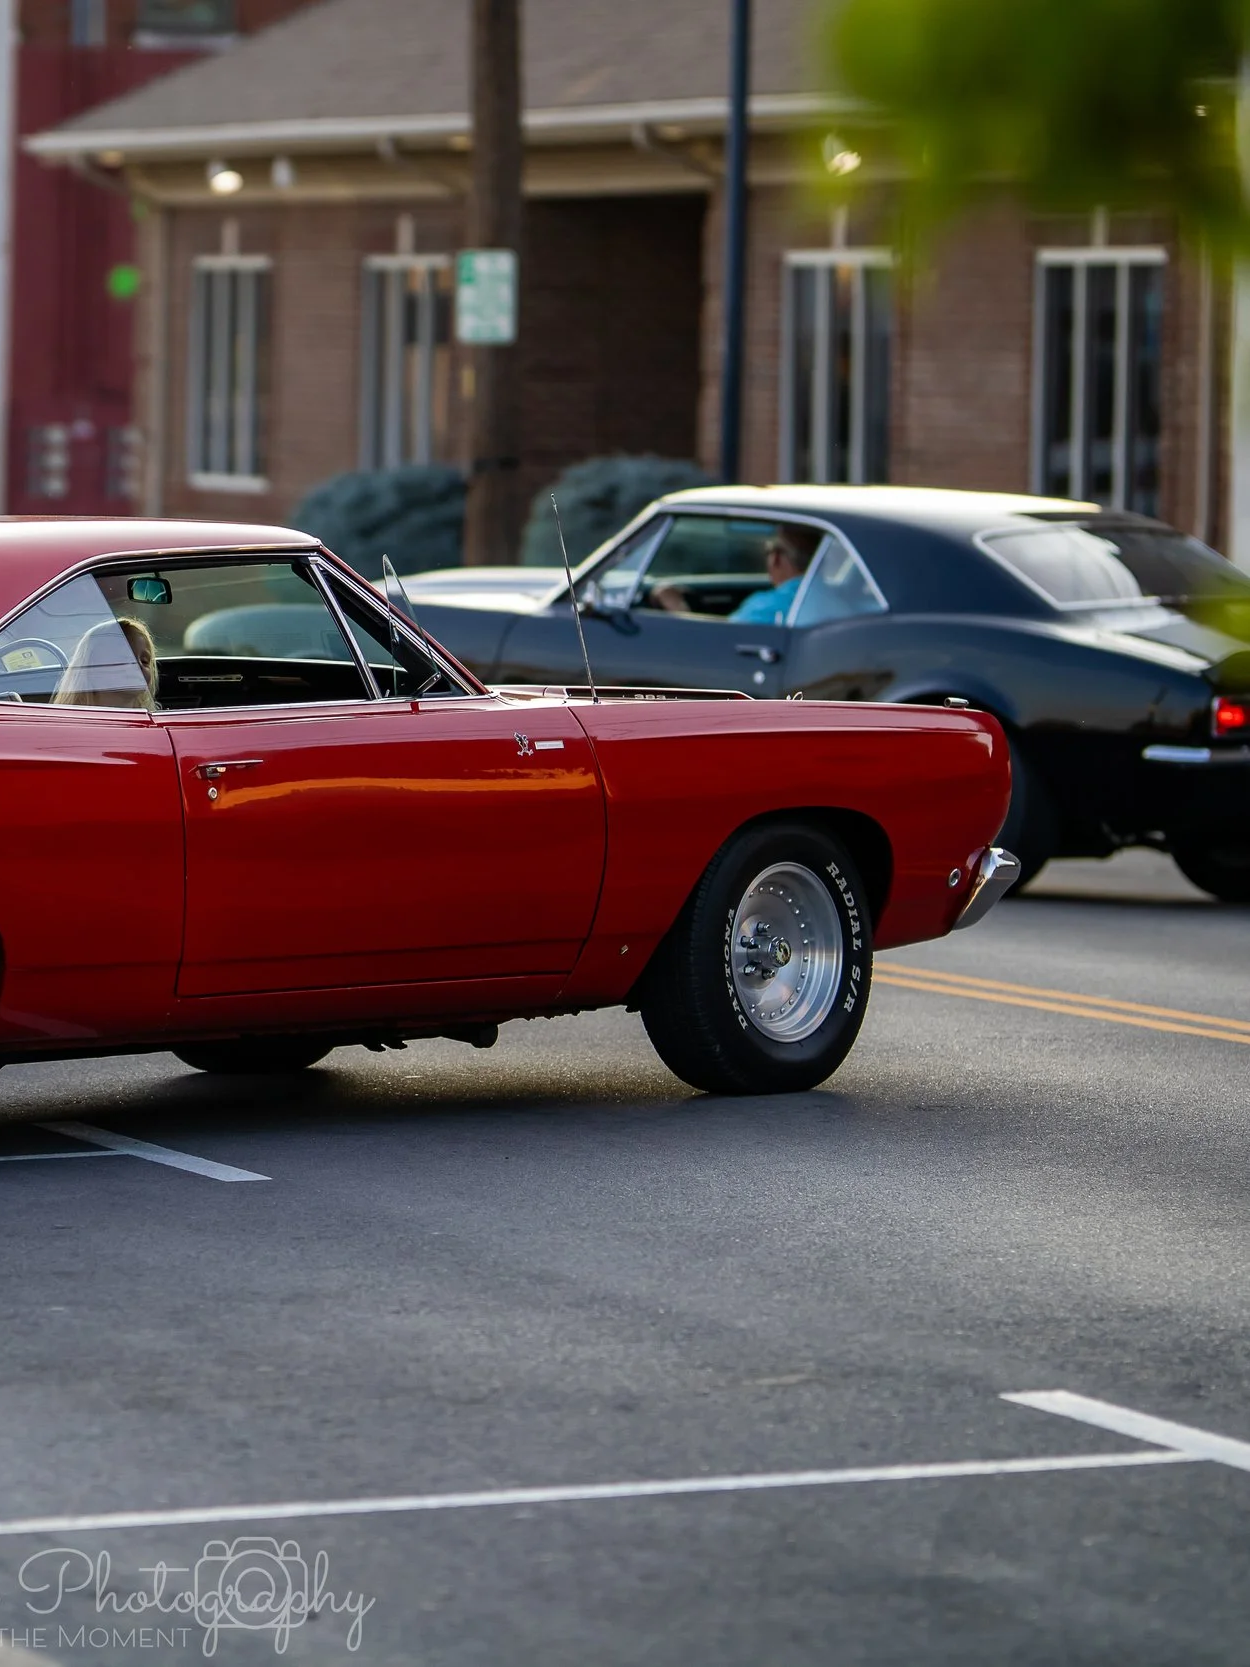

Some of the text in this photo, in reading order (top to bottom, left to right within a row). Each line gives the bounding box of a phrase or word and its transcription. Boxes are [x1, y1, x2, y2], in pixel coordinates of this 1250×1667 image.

[724, 908, 749, 1030] DAYTONA
[826, 861, 862, 1013] RADIAL S/R
